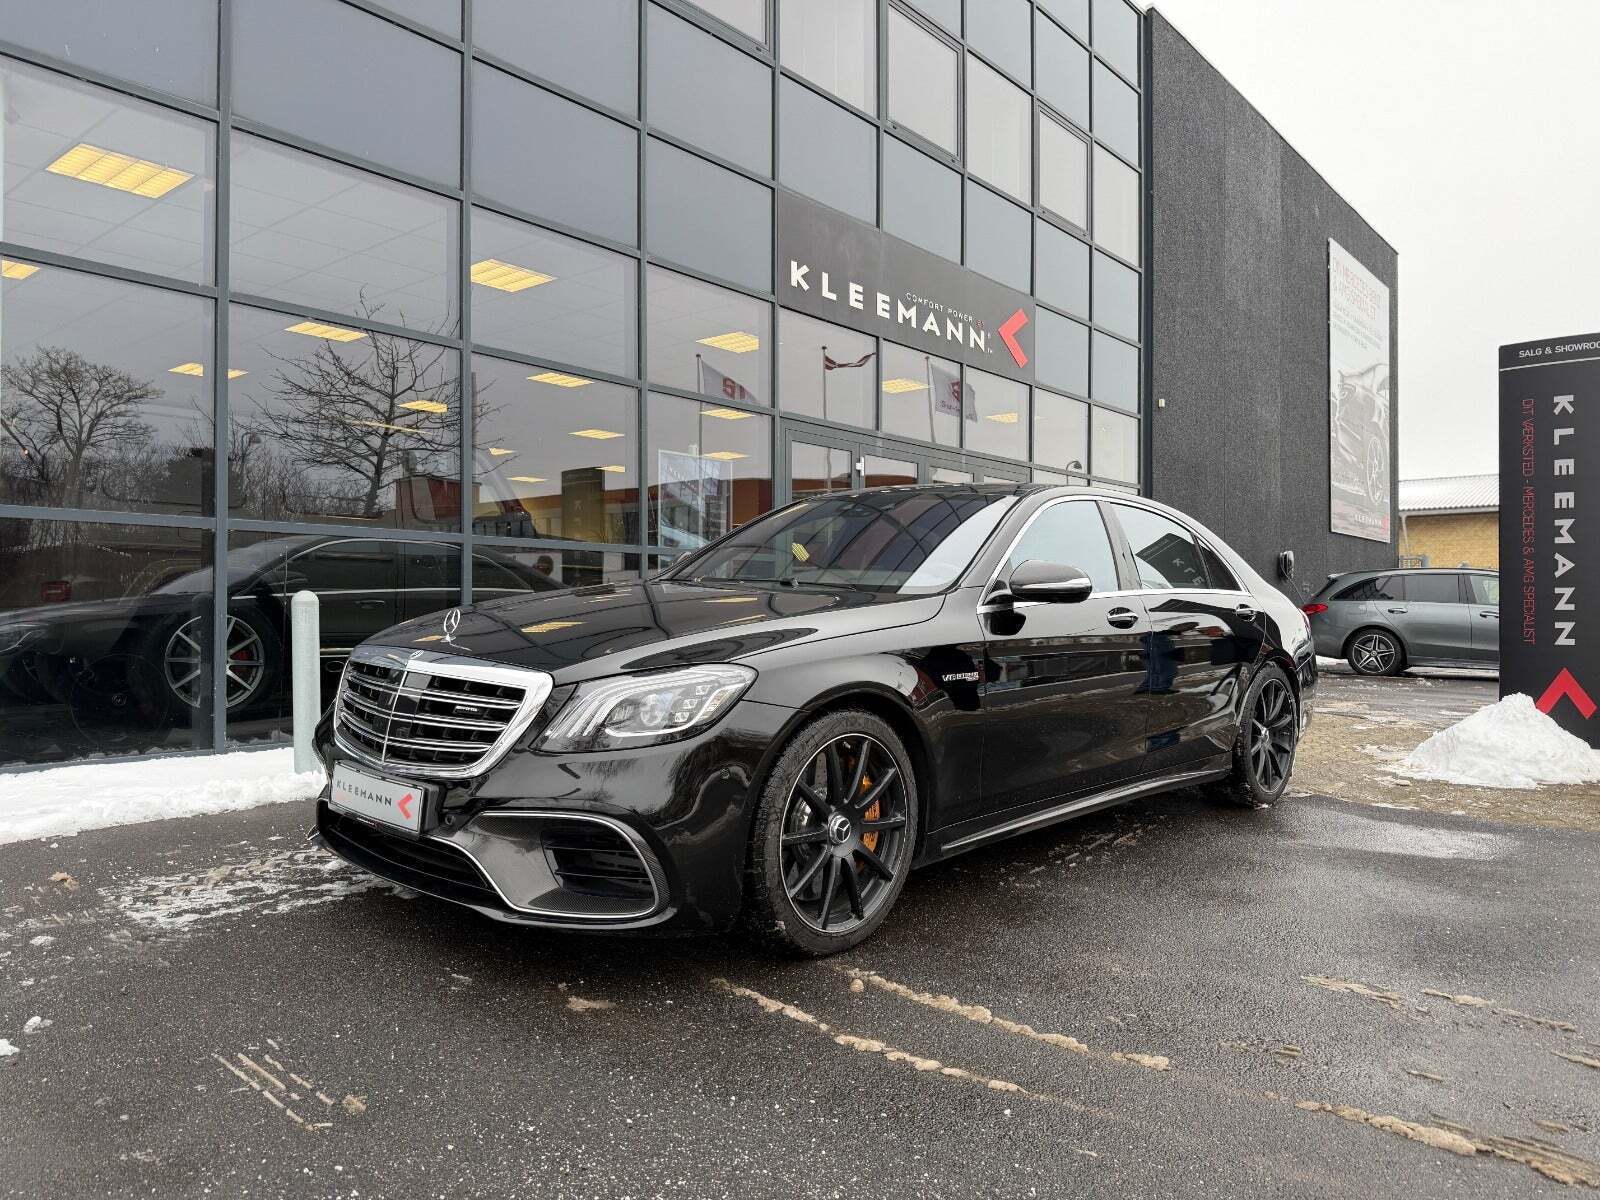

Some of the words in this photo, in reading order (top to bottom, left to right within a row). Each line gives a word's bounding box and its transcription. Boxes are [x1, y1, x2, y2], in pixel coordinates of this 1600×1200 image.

[790, 259, 985, 352] KLEEMANN
[1519, 348, 1542, 358] SALG
[1545, 346, 1552, 354] &
[1522, 398, 1534, 415] DIT
[1522, 418, 1534, 477] VÆRKSTED
[1522, 486, 1535, 544] MERCEDES
[1553, 394, 1576, 646] KLEEMANN
[1524, 558, 1535, 583] AMG
[1524, 585, 1536, 645] SPECIALIST
[336, 779, 392, 807] KLEEMANN
